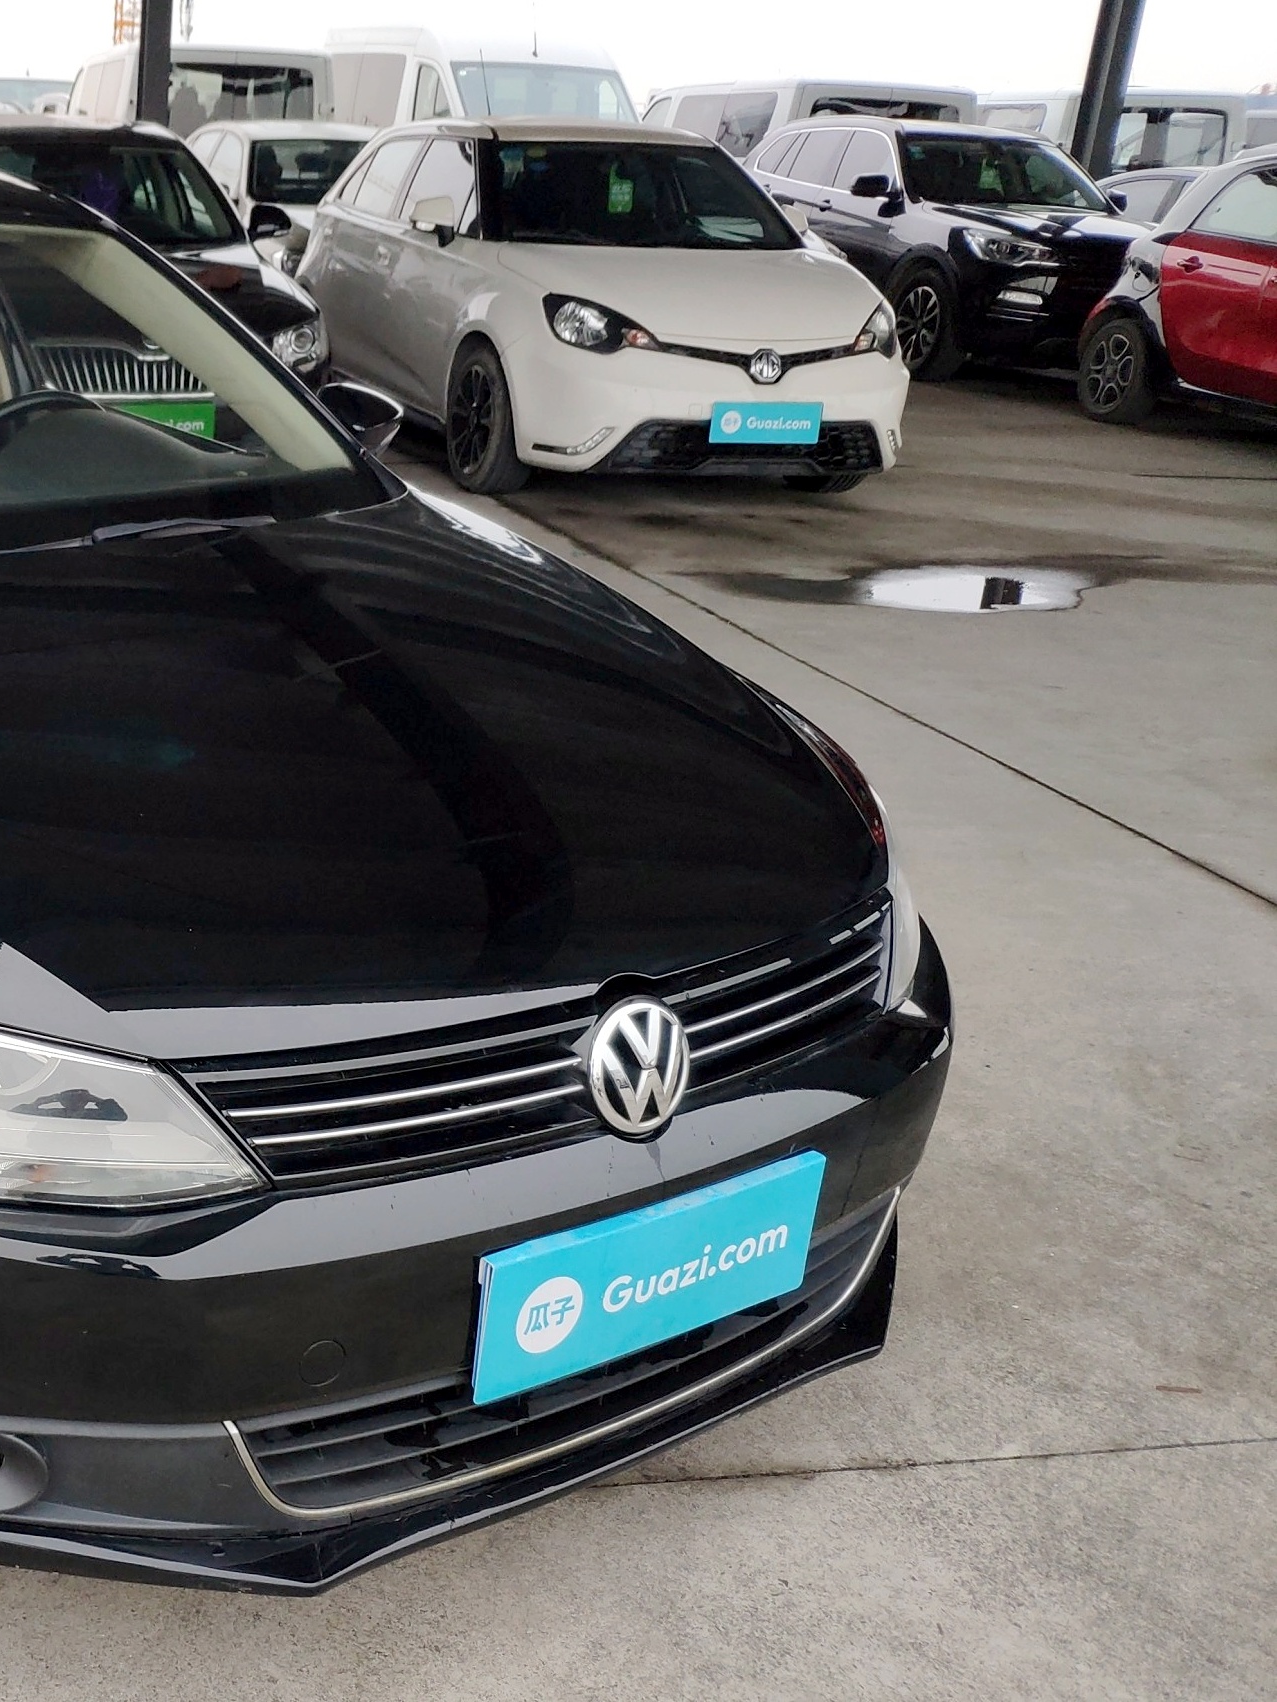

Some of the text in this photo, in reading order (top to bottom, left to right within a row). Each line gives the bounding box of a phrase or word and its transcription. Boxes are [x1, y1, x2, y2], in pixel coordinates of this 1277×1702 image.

[746, 416, 811, 430] Guazi.com
[523, 1224, 789, 1336] 瓜子 Guazi.com
